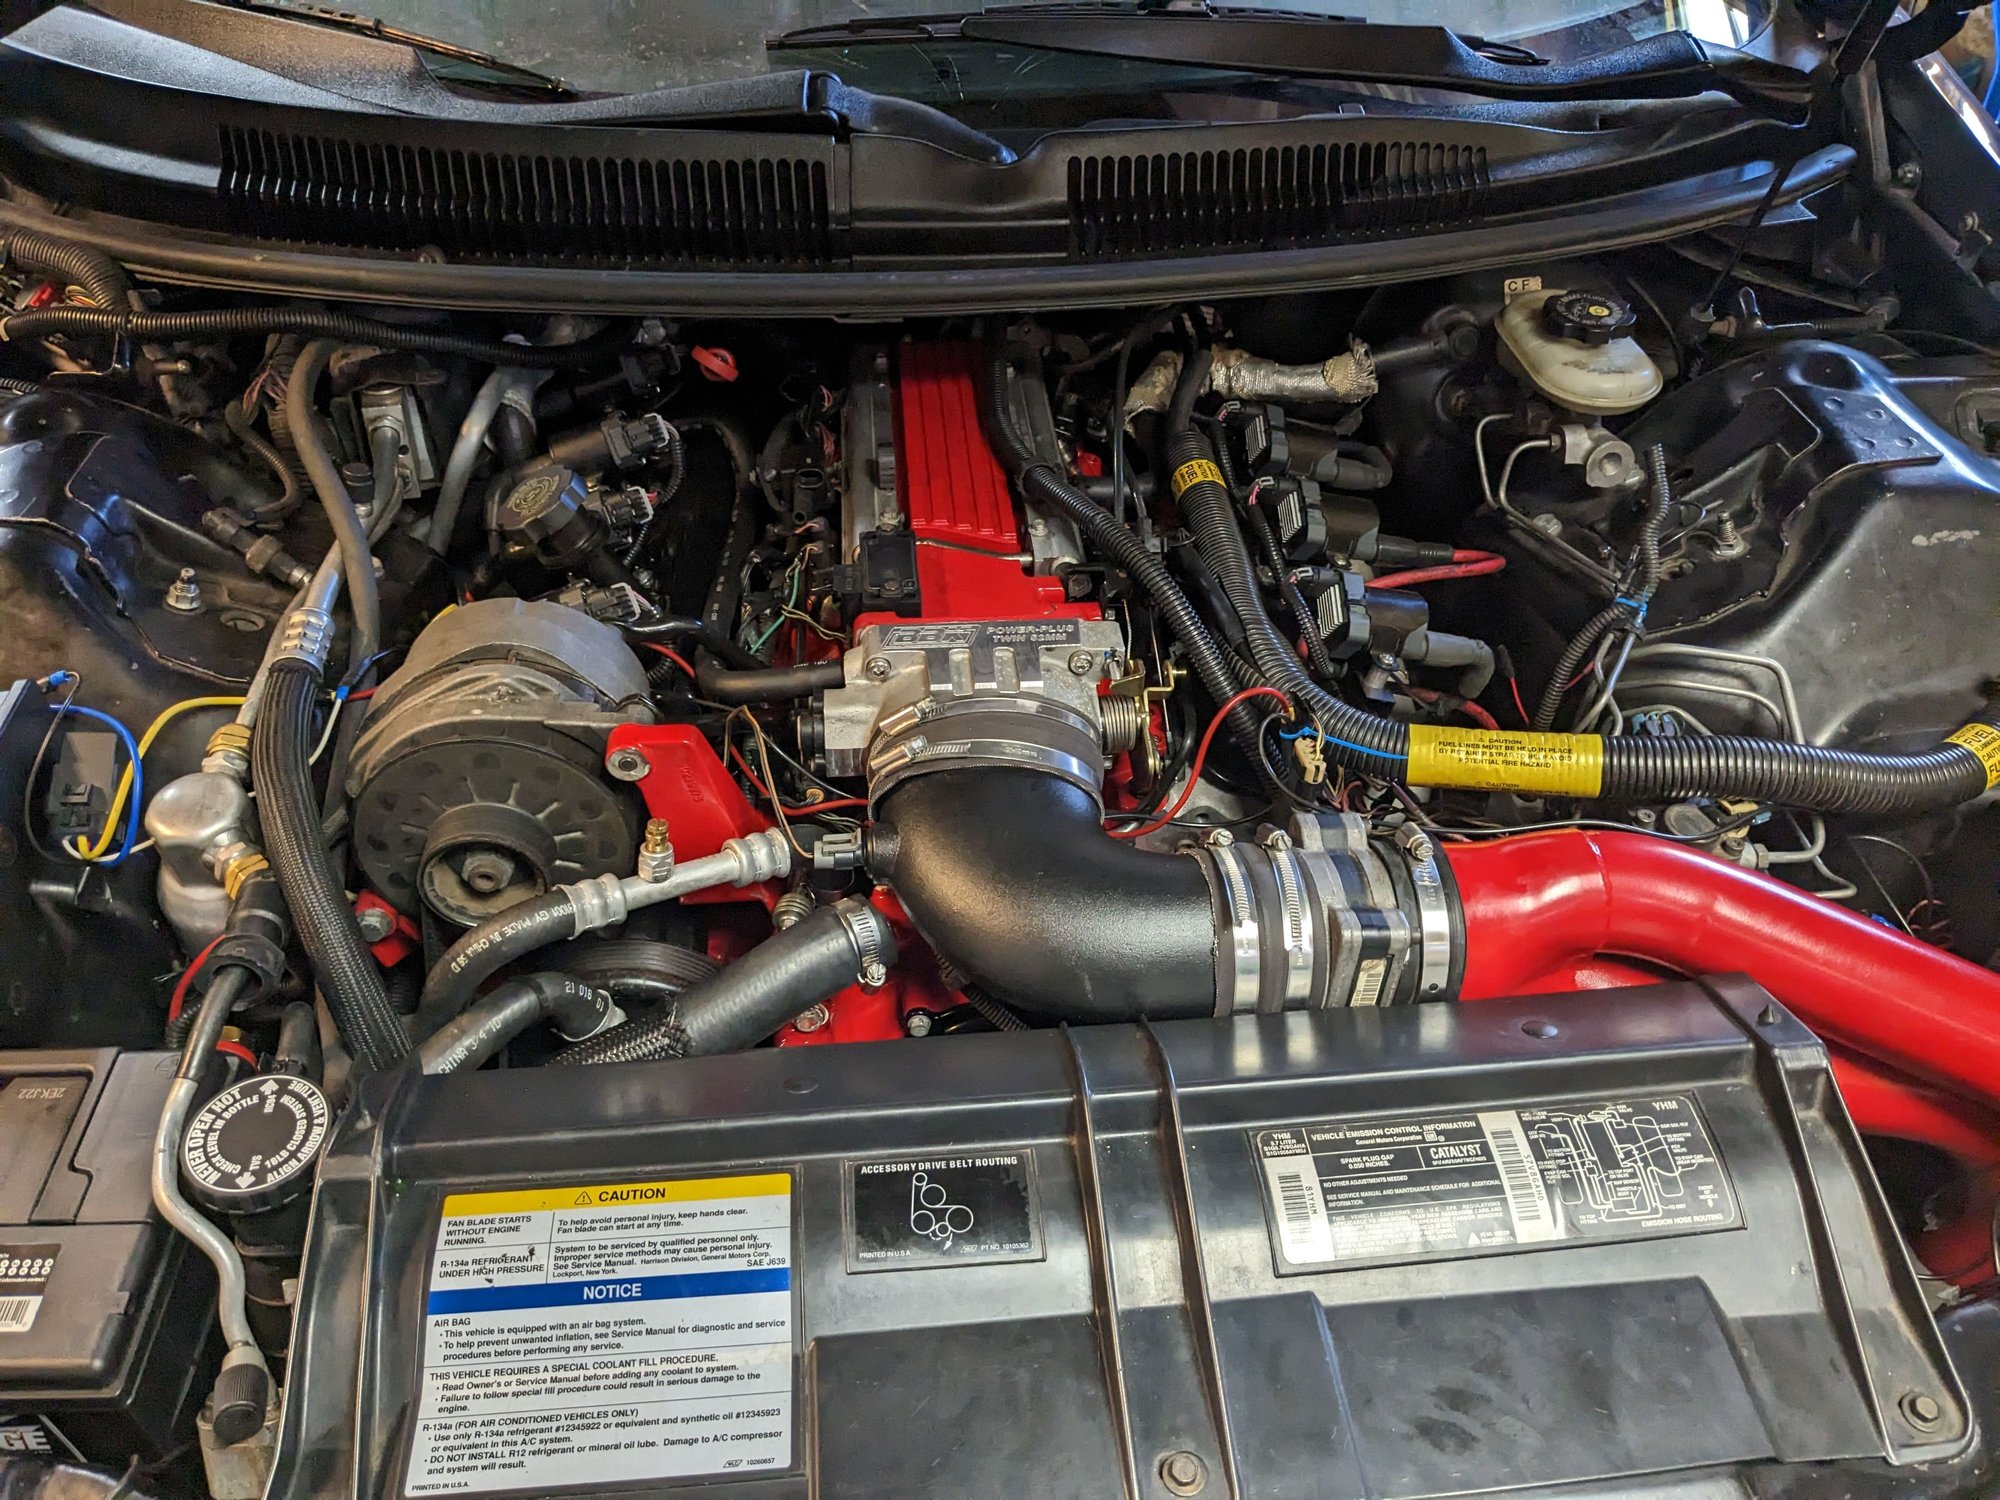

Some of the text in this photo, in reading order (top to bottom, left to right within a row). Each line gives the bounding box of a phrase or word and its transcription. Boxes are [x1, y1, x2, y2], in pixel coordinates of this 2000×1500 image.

[1184, 464, 1199, 482] FUEL
[986, 625, 1074, 634] POWER-PLUS
[1963, 729, 1994, 747] FUEL
[535, 910, 549, 923] GY
[505, 917, 531, 937] MADE
[492, 932, 502, 943] IN
[280, 1094, 307, 1119] SYSTEM
[1651, 1100, 1679, 1111] YHM
[189, 1088, 242, 1184] NEVER OPEN HOT
[207, 1095, 259, 1174] CHECK LEVEL IN BOTTLE
[267, 1080, 325, 1183] ALIGN ARROW & VENT TUBE
[287, 1119, 307, 1150] CLOSED
[1310, 1120, 1477, 1141] VEHICLE EMISSION CONTROL INFORMATION
[1392, 1133, 1423, 1142] Corporation
[1428, 1143, 1483, 1159] CATALYST
[860, 1155, 1017, 1174] ACCESSORY DRIVE BELT ROUTING
[1339, 1156, 1362, 1164] SPARK
[1349, 1176, 1387, 1185] ADJUSTMENTS
[1386, 1174, 1408, 1182] NEEDED
[1393, 1185, 1431, 1194] MAINTENANCE
[1470, 1179, 1501, 1187] ADDITIONAL
[598, 1188, 665, 1202] CAUTION
[1304, 1186, 1318, 1215] 81YHM
[447, 1215, 531, 1227] FAN BLADE STARTS
[569, 1217, 588, 1227] help
[589, 1216, 611, 1224] avoid
[613, 1213, 649, 1224] personal
[651, 1212, 676, 1222] injury,
[677, 1210, 697, 1220] keep
[699, 1208, 724, 1217] hands
[726, 1207, 747, 1215] clear.
[1639, 1213, 1724, 1227] EMISSION HOSE ROUTING
[445, 1225, 520, 1237] WITHOUT ENGINE
[556, 1226, 572, 1234] Fan
[574, 1224, 597, 1233] blade
[615, 1222, 634, 1230] start
[646, 1221, 661, 1229] any
[663, 1219, 683, 1227] time.
[443, 1236, 484, 1246] RUNNING.
[440, 1255, 533, 1268] R-134a REFRIGERANT
[746, 1257, 785, 1267] SAE J639
[859, 1251, 885, 1259] PRINTED
[438, 1263, 544, 1278] UNDER HIGH PRESSURE
[552, 1257, 636, 1270] See Service Manual.
[583, 1283, 642, 1300] NOTICE
[433, 1317, 471, 1327] AIR BAG
[444, 1329, 463, 1338] This
[464, 1327, 495, 1336] vehicle
[497, 1326, 505, 1334] is
[506, 1323, 547, 1335] equipped
[548, 1322, 567, 1330] with
[581, 1320, 593, 1328] air
[594, 1319, 610, 1329] bag
[612, 1316, 645, 1327] system.
[429, 1352, 717, 1381] THIS VEHICLE REQUIRES A SPECIAL COOLANT FILL PROCEDURE.
[422, 1408, 638, 1432] R-134a (FOR AIR CONDITIONED VEHICLES ONLY)
[411, 1483, 441, 1491] PRINTED
